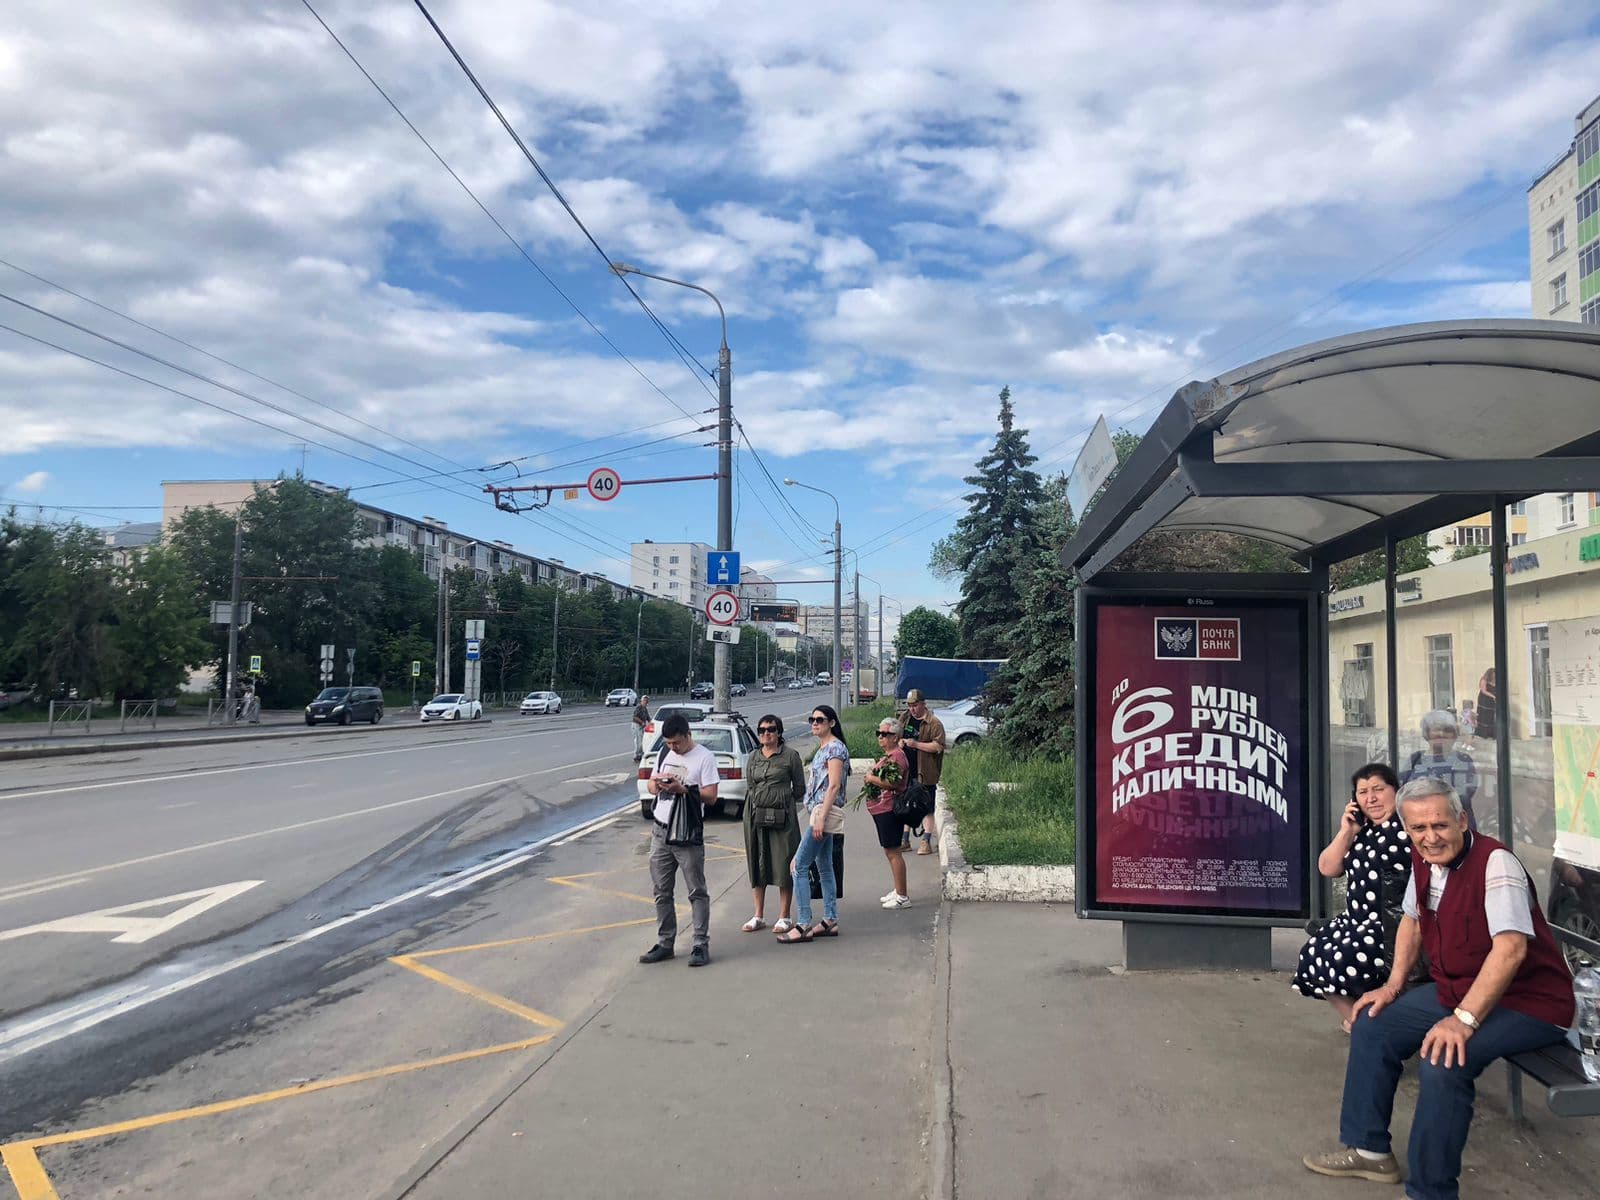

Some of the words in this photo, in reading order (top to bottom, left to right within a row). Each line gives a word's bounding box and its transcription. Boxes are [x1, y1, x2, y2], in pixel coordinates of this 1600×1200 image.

[594, 477, 613, 491] 40
[713, 601, 732, 614] 40
[1202, 628, 1235, 639] ПОЧТА
[1202, 639, 1231, 650] БАНК
[1112, 678, 1129, 706] ДО
[1191, 685, 1257, 718] МЛН
[1111, 687, 1174, 744] 6
[1191, 707, 1288, 762] РУБЛЕЙ
[1112, 732, 1288, 790] КРЕДИТ
[1112, 766, 1288, 823] НАЛИЧНЫМИ
